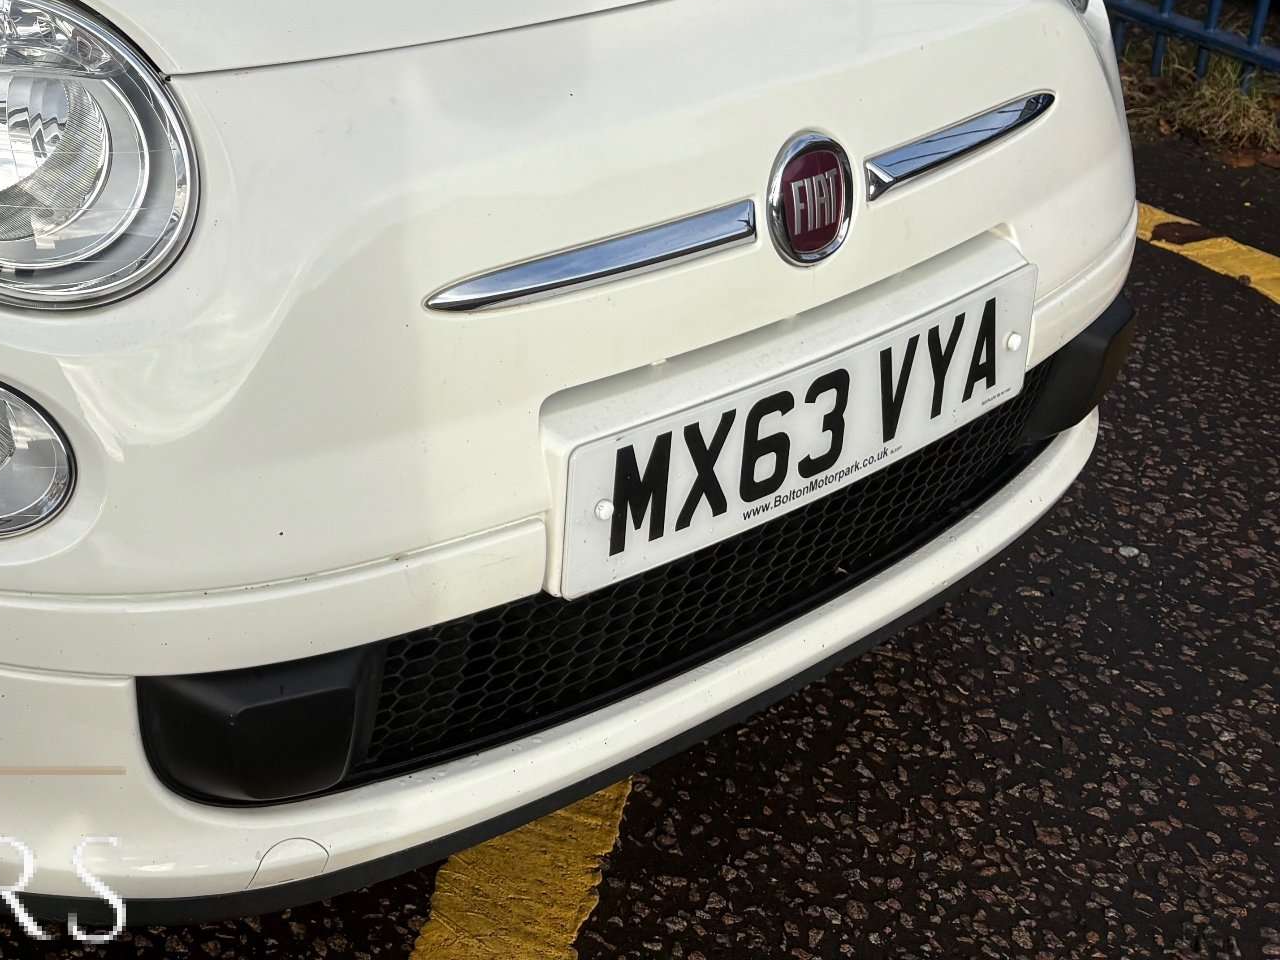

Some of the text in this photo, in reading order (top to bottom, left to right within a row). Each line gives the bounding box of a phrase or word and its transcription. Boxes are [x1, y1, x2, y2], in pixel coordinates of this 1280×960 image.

[790, 167, 839, 236] FIAT
[609, 297, 997, 557] MX63 VYA
[742, 446, 890, 521] www.BoltonMotorpark.co.uk
